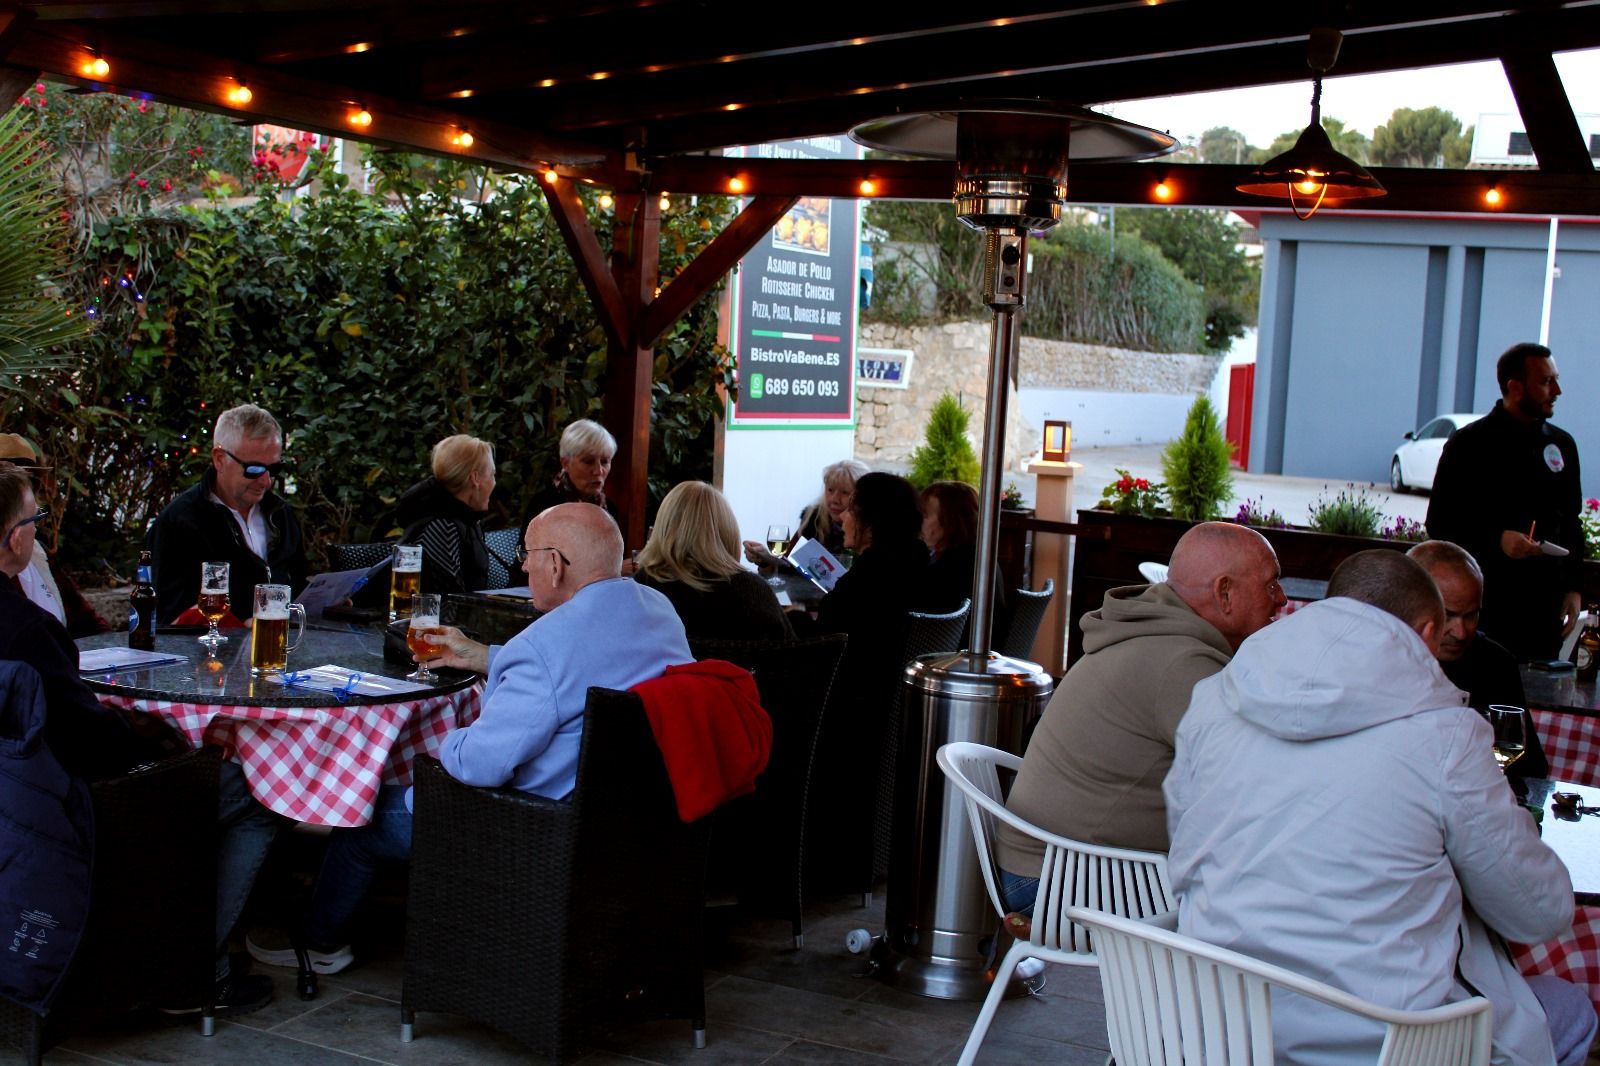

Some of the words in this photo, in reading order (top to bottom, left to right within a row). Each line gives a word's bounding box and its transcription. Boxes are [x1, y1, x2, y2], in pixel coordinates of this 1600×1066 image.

[767, 256, 797, 276] ASADOR
[810, 262, 832, 281] POLLO
[762, 277, 803, 298] ROTISSERIE
[805, 282, 835, 301] CHICKEN
[820, 308, 826, 324] &
[751, 347, 840, 366] BistroVaBene.ES
[765, 377, 789, 395] 689
[792, 379, 815, 396] 650
[818, 380, 839, 396] 093
